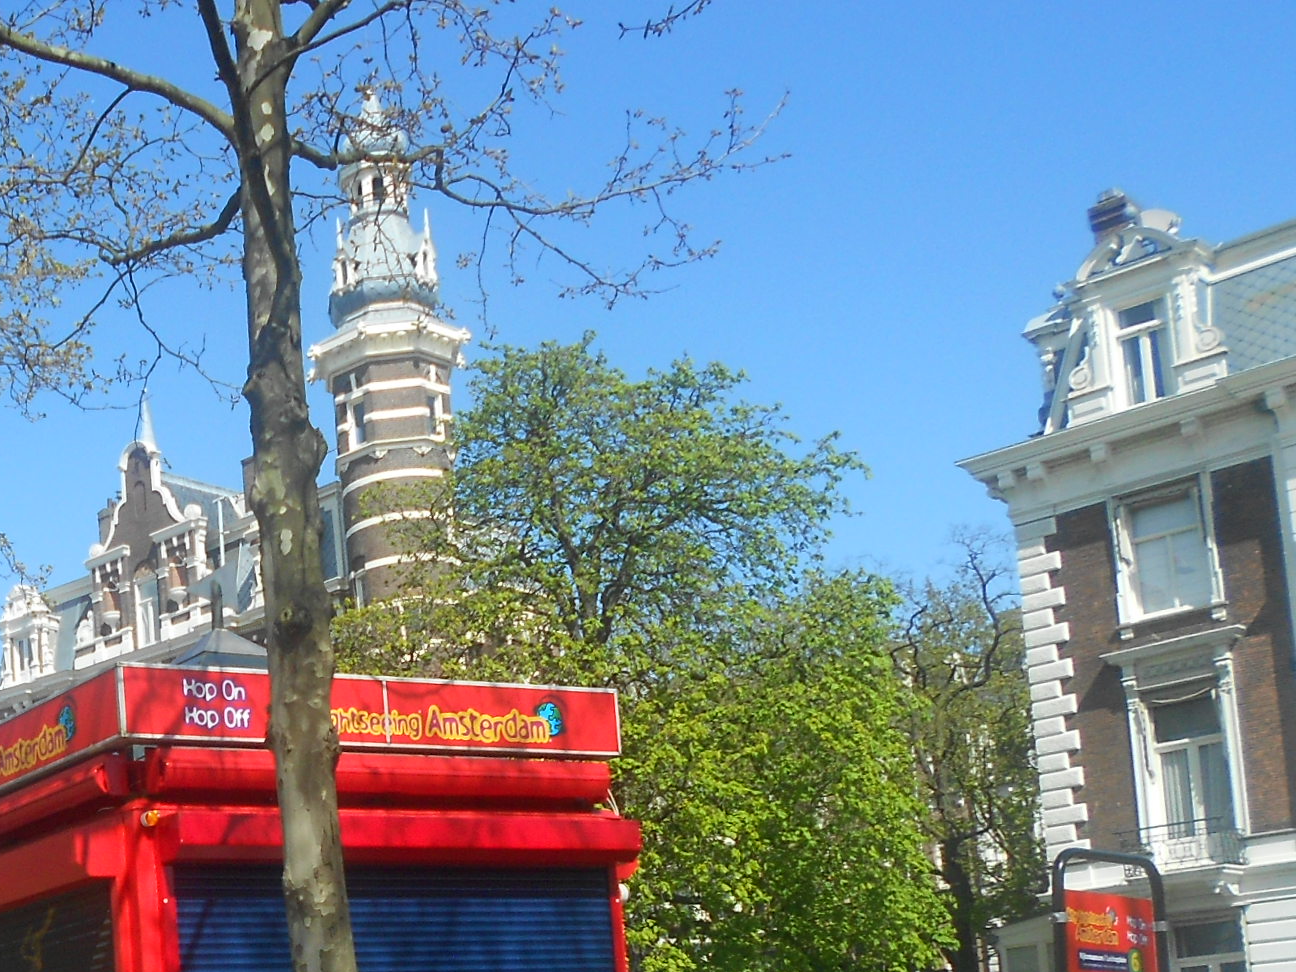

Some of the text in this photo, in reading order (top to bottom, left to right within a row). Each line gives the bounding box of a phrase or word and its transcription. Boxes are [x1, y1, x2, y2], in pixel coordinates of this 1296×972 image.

[182, 678, 245, 701] Hop On
[184, 706, 250, 729] Hop Off
[425, 704, 550, 743] Amsterdam
[1131, 951, 1141, 972] 6
